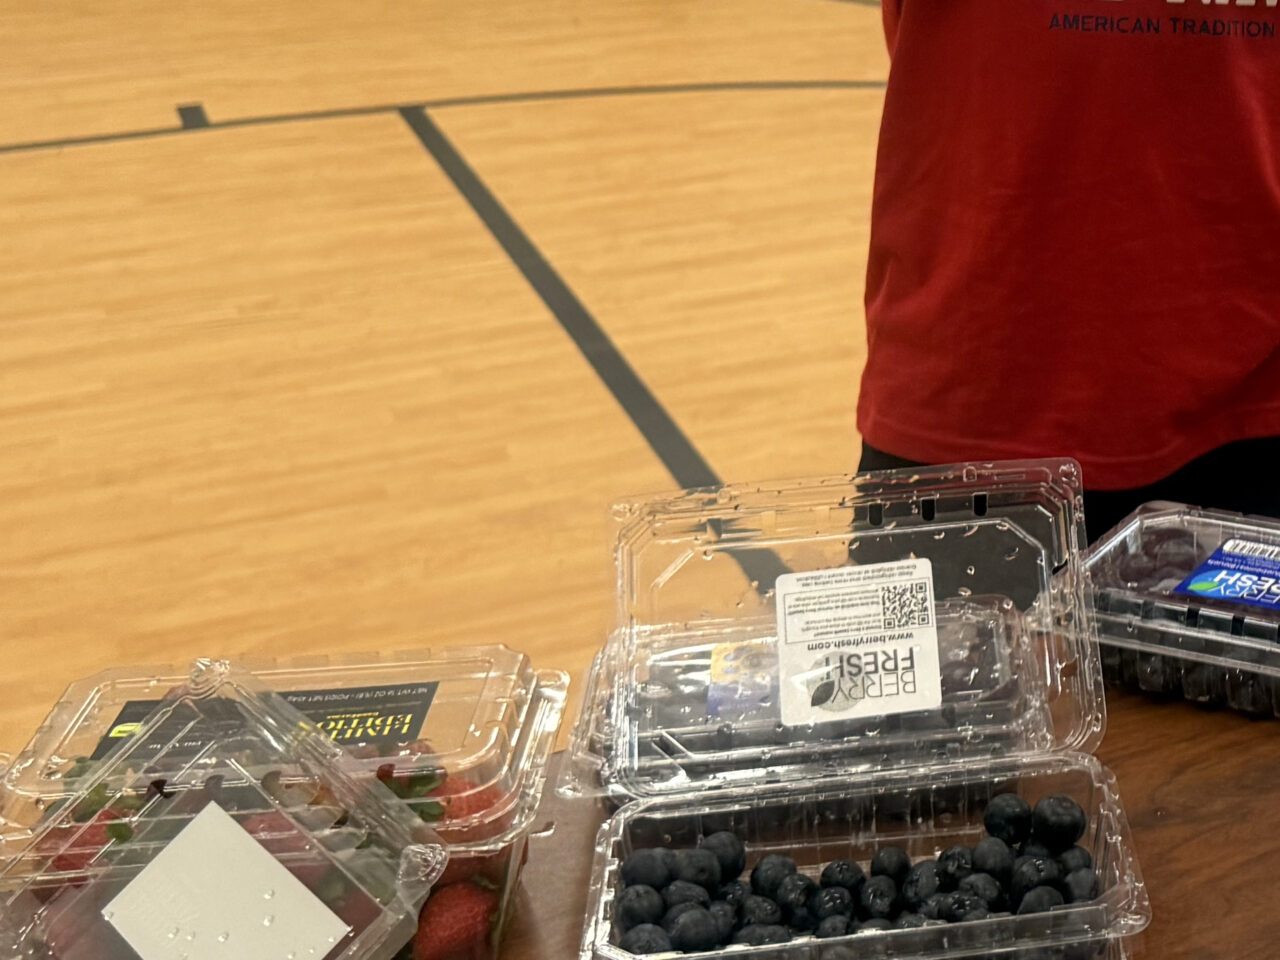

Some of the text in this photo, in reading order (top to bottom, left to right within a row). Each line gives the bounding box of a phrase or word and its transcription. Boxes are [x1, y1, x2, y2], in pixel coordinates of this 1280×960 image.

[1049, 13, 1275, 38] AMERICAN TRADITION
[807, 631, 914, 651] www.berryfresh.com
[825, 647, 915, 681] FRESH
[832, 670, 917, 704] BERRY
